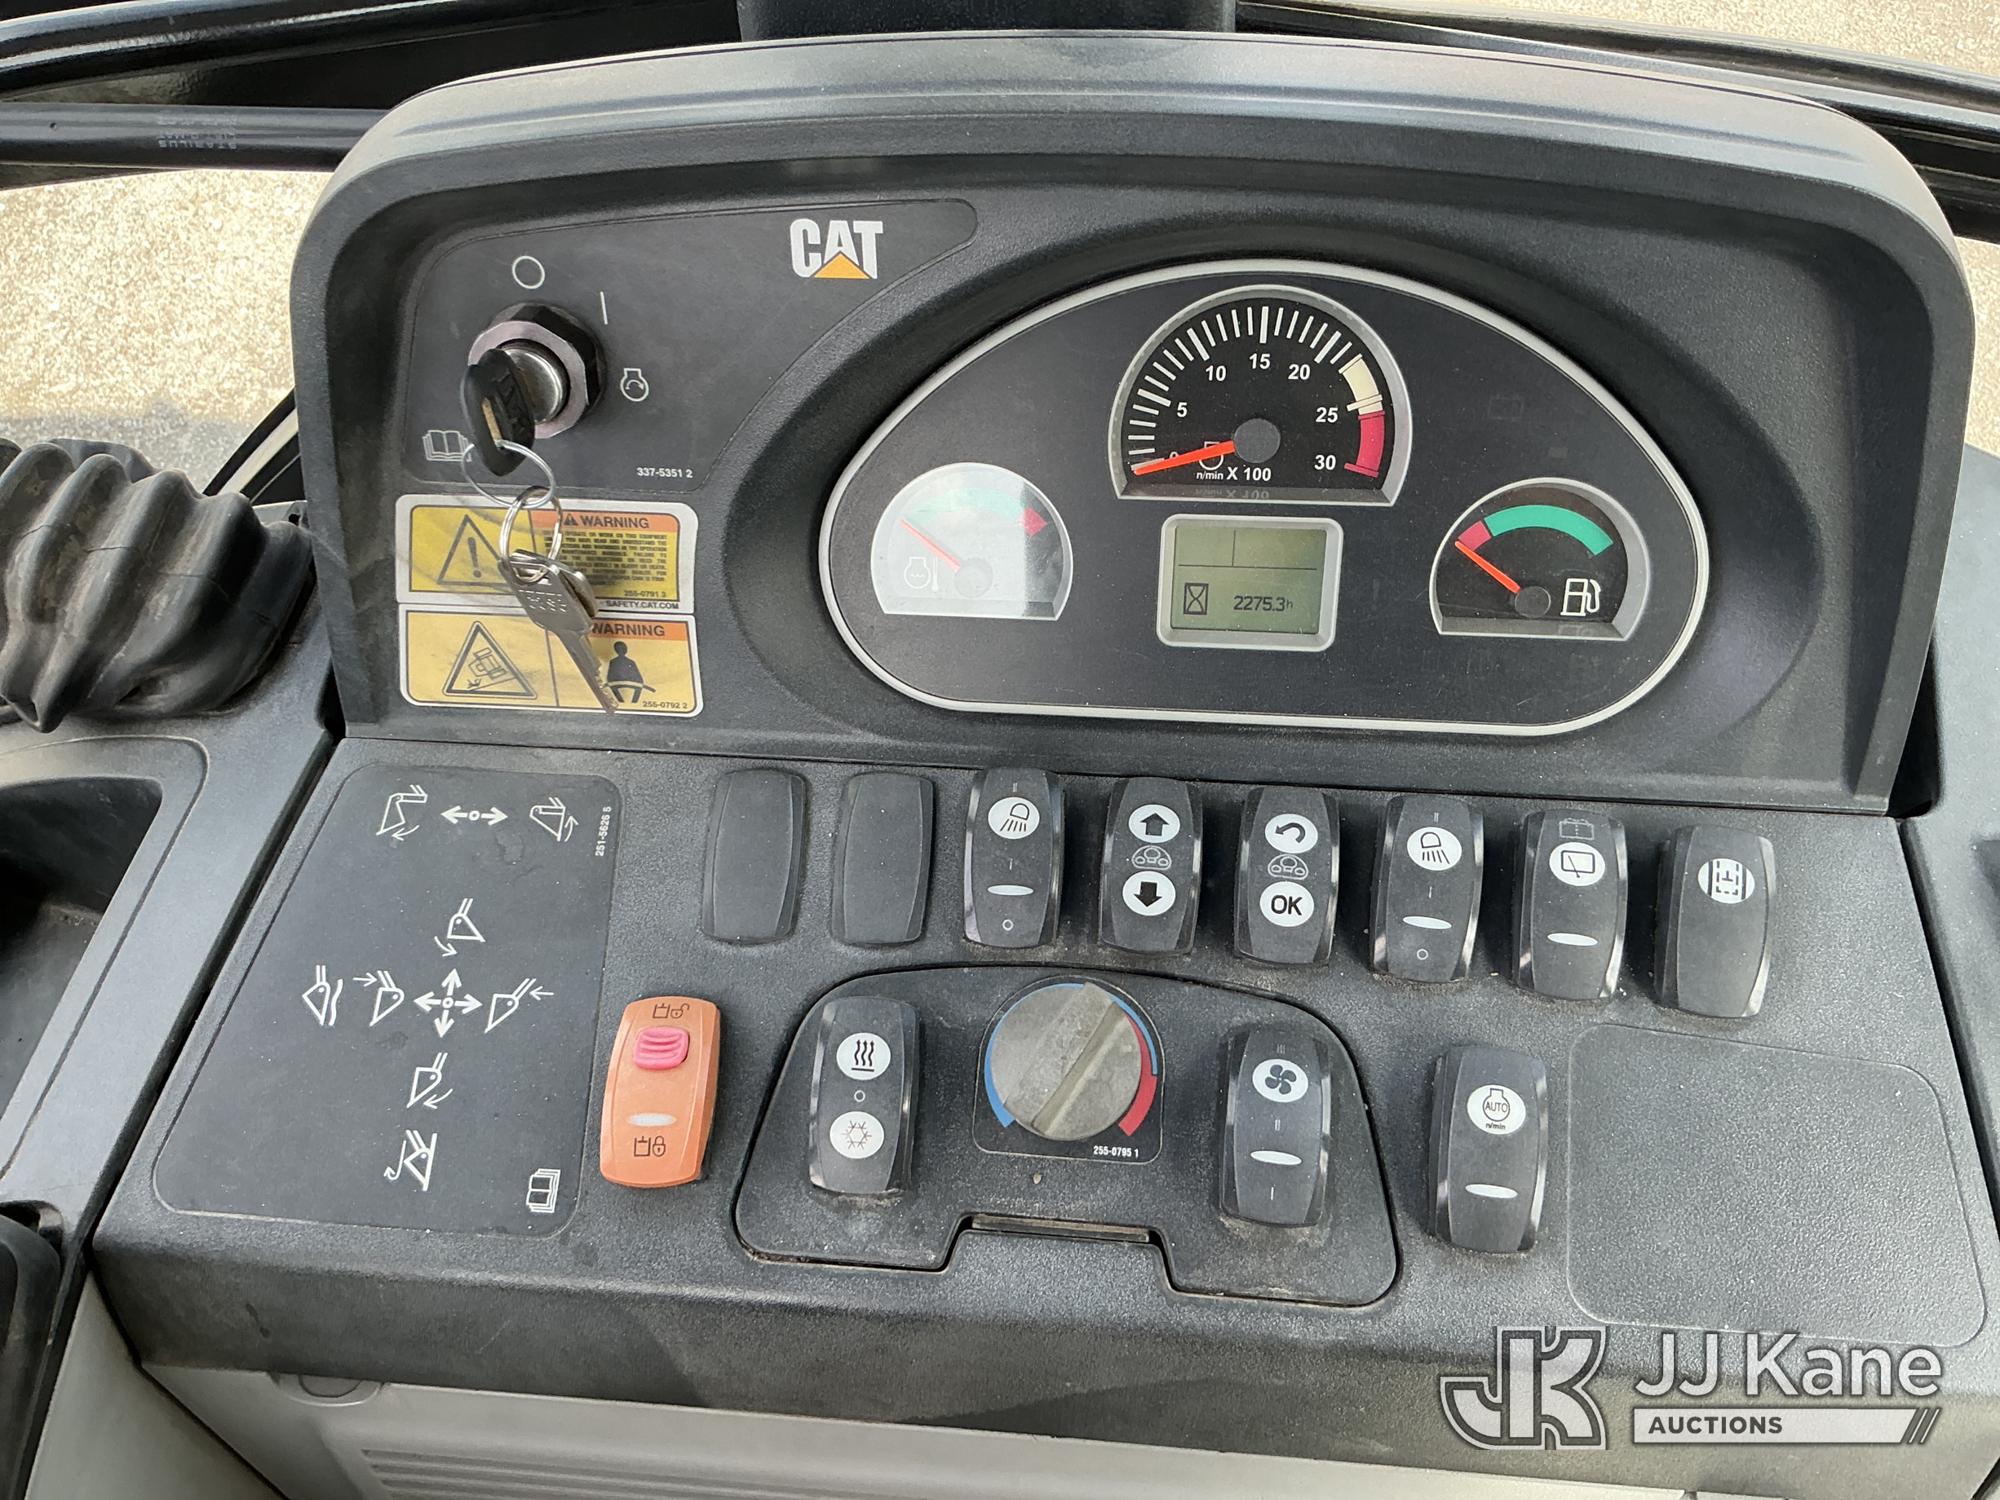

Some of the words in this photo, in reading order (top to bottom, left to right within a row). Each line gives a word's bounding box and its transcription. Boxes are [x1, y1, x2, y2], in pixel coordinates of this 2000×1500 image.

[790, 218, 883, 279] CAT
[1249, 353, 1271, 370] 15
[1205, 365, 1227, 382] 10
[1288, 364, 1311, 381] 20
[1176, 402, 1188, 418] 5
[1315, 407, 1338, 423] 25
[1314, 454, 1336, 470] 30
[636, 467, 683, 478] 337-5351
[685, 468, 693, 479] 2
[1196, 470, 1224, 480] n/min
[1226, 466, 1239, 481] X
[1243, 467, 1272, 482] 100
[580, 515, 649, 529] WARNING
[606, 600, 679, 610] SAFETY.CAT.COM
[592, 622, 665, 637] WARNING
[595, 814, 610, 856] 251-5626
[1271, 894, 1303, 916] OK
[1484, 1102, 1509, 1113] AUTO
[1093, 1145, 1132, 1158] 255-0795
[1134, 1148, 1139, 1158] 1
